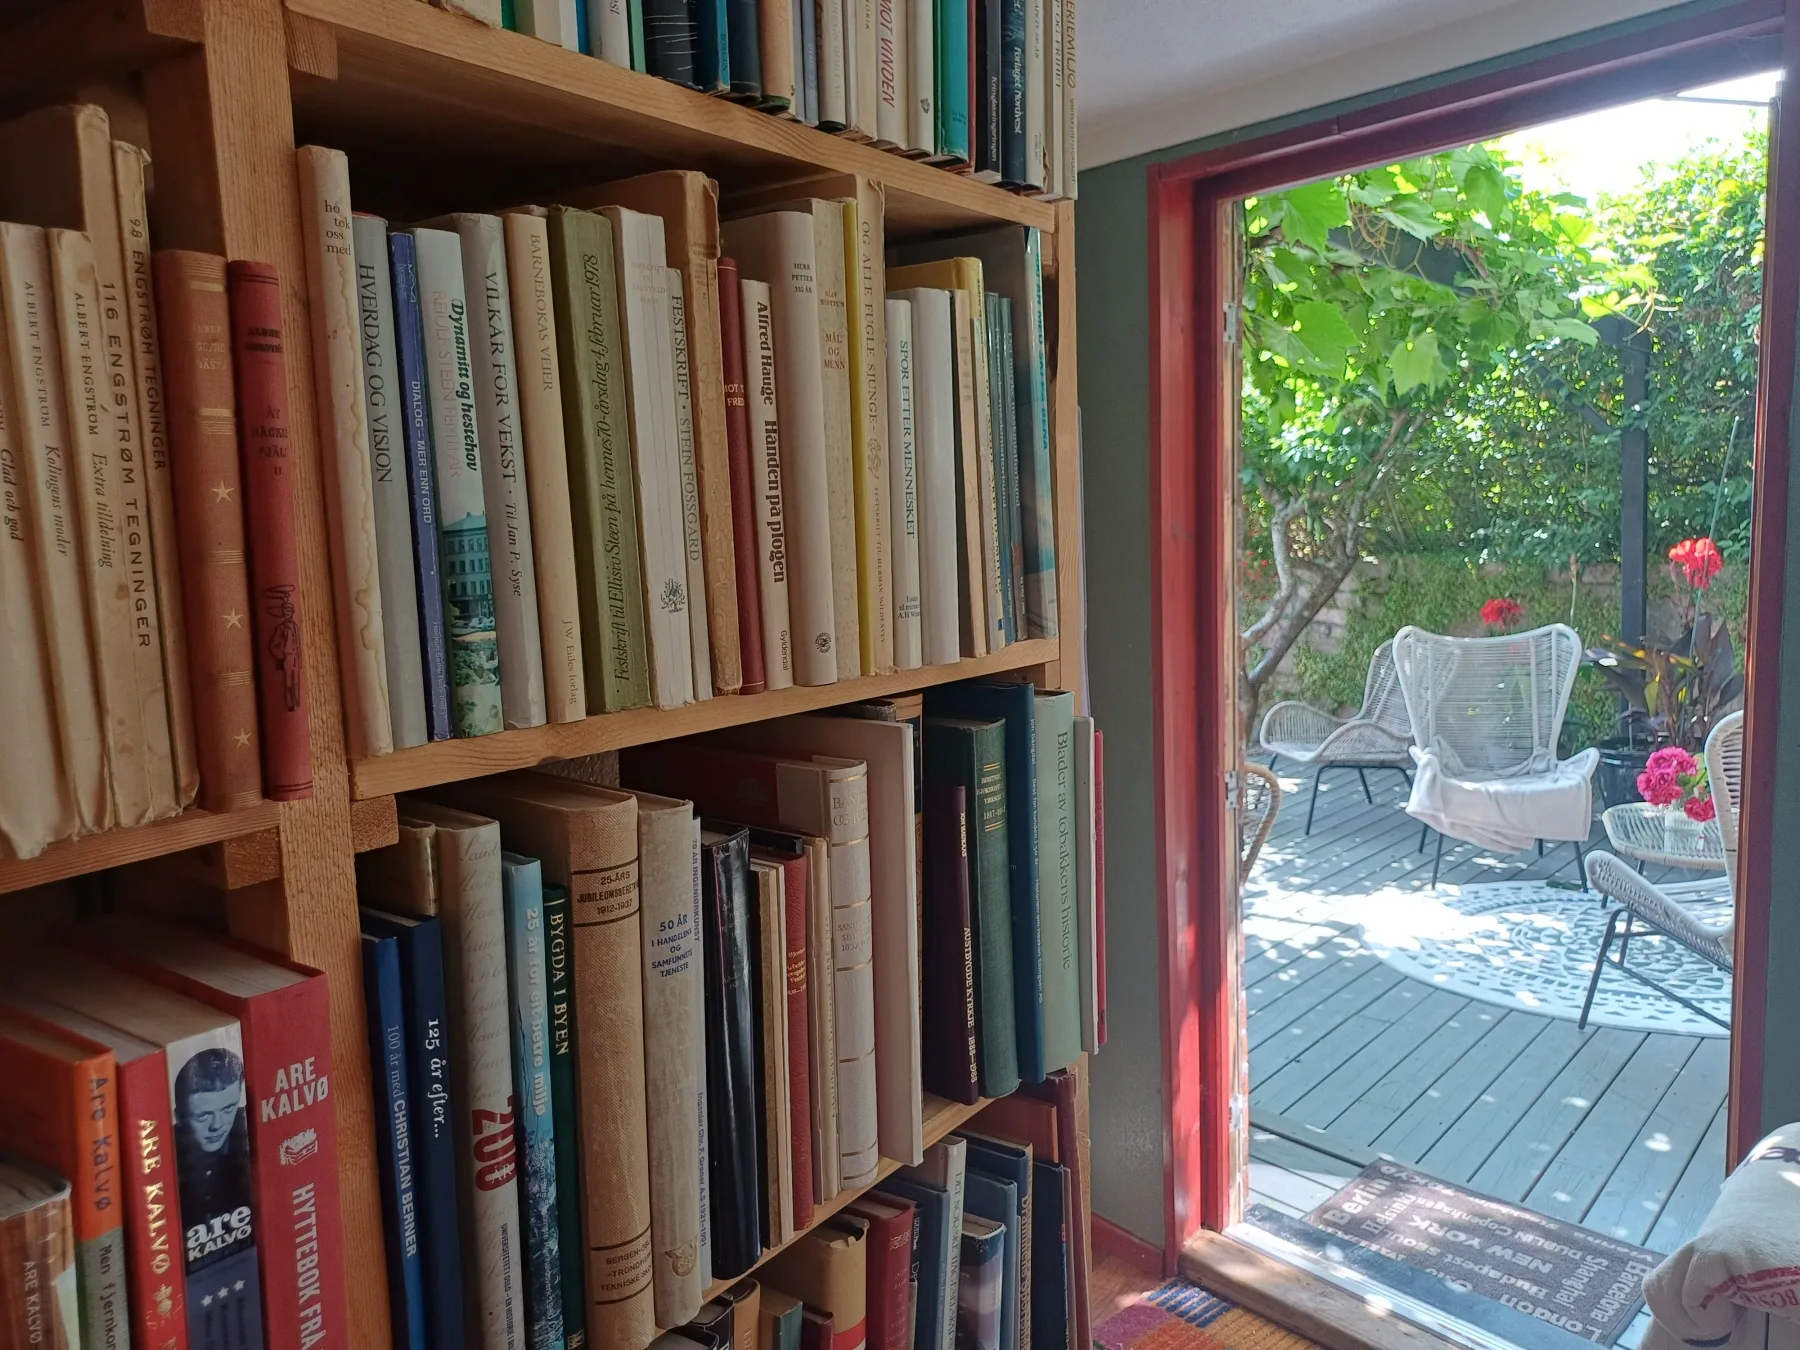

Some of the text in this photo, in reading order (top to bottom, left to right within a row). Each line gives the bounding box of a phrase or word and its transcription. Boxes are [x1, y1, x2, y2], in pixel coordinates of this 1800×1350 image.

[880, 37, 895, 108] VINDEN
[1014, 89, 1023, 134] Nordvest
[326, 230, 344, 240] oss
[326, 244, 351, 256] med
[583, 253, 601, 289] 1978
[791, 274, 813, 283] PETTER
[793, 263, 811, 271] HERR
[861, 221, 875, 357] OG ALLE FUGLE
[74, 292, 90, 350] ALBERT
[432, 290, 452, 347] REIULF
[530, 233, 554, 391] BARNEBOKAS VEIER
[588, 286, 609, 354] februar
[757, 301, 772, 351] Alfred
[129, 218, 166, 470] 98 ENGSTRØM TEGNINGER
[825, 332, 843, 344] MÅL
[828, 347, 840, 357] OG
[359, 262, 393, 483] HVERDAG OG VISJON
[449, 298, 477, 471] Dynamitt og hestehov
[760, 354, 774, 406] Hauge
[823, 359, 846, 370] MENN
[24, 281, 40, 341] ALBERT
[45, 444, 63, 510] Kolingens
[54, 514, 71, 557] moder
[485, 271, 523, 597] VILKÅR FOR VEKST Til Jan Syse
[671, 295, 700, 562] FESTSKRIFT STEIN FOSSGARD
[900, 340, 915, 540] SPOR ETTER MENNESKET
[0, 448, 17, 486] Glad
[92, 452, 108, 497] Extra
[103, 283, 151, 648] 116 ENGSTRØM TEGNINGER
[411, 381, 431, 523] DIALOG MER ENN ORD
[600, 438, 616, 490] hennes
[601, 494, 622, 515] på
[4, 515, 24, 542] god
[97, 501, 116, 568] tilldelning
[605, 515, 621, 556] Steen
[767, 521, 785, 584] plogen
[606, 556, 624, 603] Ellisiv
[610, 603, 625, 620] til
[566, 643, 576, 672] Eides
[611, 621, 631, 681] Festskrift
[780, 629, 789, 671] Gyldendal
[568, 674, 580, 705] forlag
[692, 838, 698, 849] 70
[692, 851, 699, 862] ÅR
[1057, 731, 1071, 971] Blader av tobakkens historie
[600, 871, 631, 886] 25-ÅRS
[526, 907, 540, 932] 25
[596, 899, 634, 915] 1912-1937
[659, 913, 689, 932] 50 ÅR
[692, 864, 700, 942] INGENIØRKUNST
[527, 937, 541, 954] år
[656, 927, 693, 946] HANDELENS
[669, 943, 682, 953] OG
[963, 926, 973, 988] AUSTBYGDE
[527, 963, 541, 986] for
[549, 911, 569, 1056] BYGDA BYEN
[660, 961, 690, 978] TJENESTE
[966, 988, 975, 1029] KYRKJE
[425, 1018, 441, 1050] 125
[531, 1021, 544, 1069] betre
[275, 1056, 316, 1093] ARE
[430, 1057, 447, 1079] år
[261, 1075, 329, 1122] KALVØ
[89, 1076, 114, 1211] Are Kalvø
[387, 1024, 418, 1258] 100 år med CHRISTIAN BERNER
[139, 1118, 170, 1275] ARE KALVØ
[1323, 1177, 1393, 1226] Berlin
[1380, 1164, 1456, 1196] TOKYO
[187, 1205, 252, 1250] are
[1360, 1191, 1417, 1235] Helsinki
[1407, 1214, 1482, 1250] YORK
[1413, 1196, 1584, 1261] DUBLIN Copenhagen
[100, 1244, 112, 1275] Men
[188, 1225, 252, 1262] KALVØ
[291, 1182, 321, 1298] HYTTEBOK
[1383, 1229, 1441, 1256] SEOUL
[1485, 1244, 1554, 1274] NEW
[501, 1222, 515, 1336] UNIVERSITETET OSLO HISTORIE
[600, 1273, 641, 1292] TEKNISKE
[1443, 1253, 1551, 1300] Budapest
[1553, 1254, 1610, 1315] Shanghai
[1588, 1260, 1651, 1324] Barcelona
[24, 1260, 43, 1345] ARE KALVØ
[1499, 1293, 1603, 1344] London
